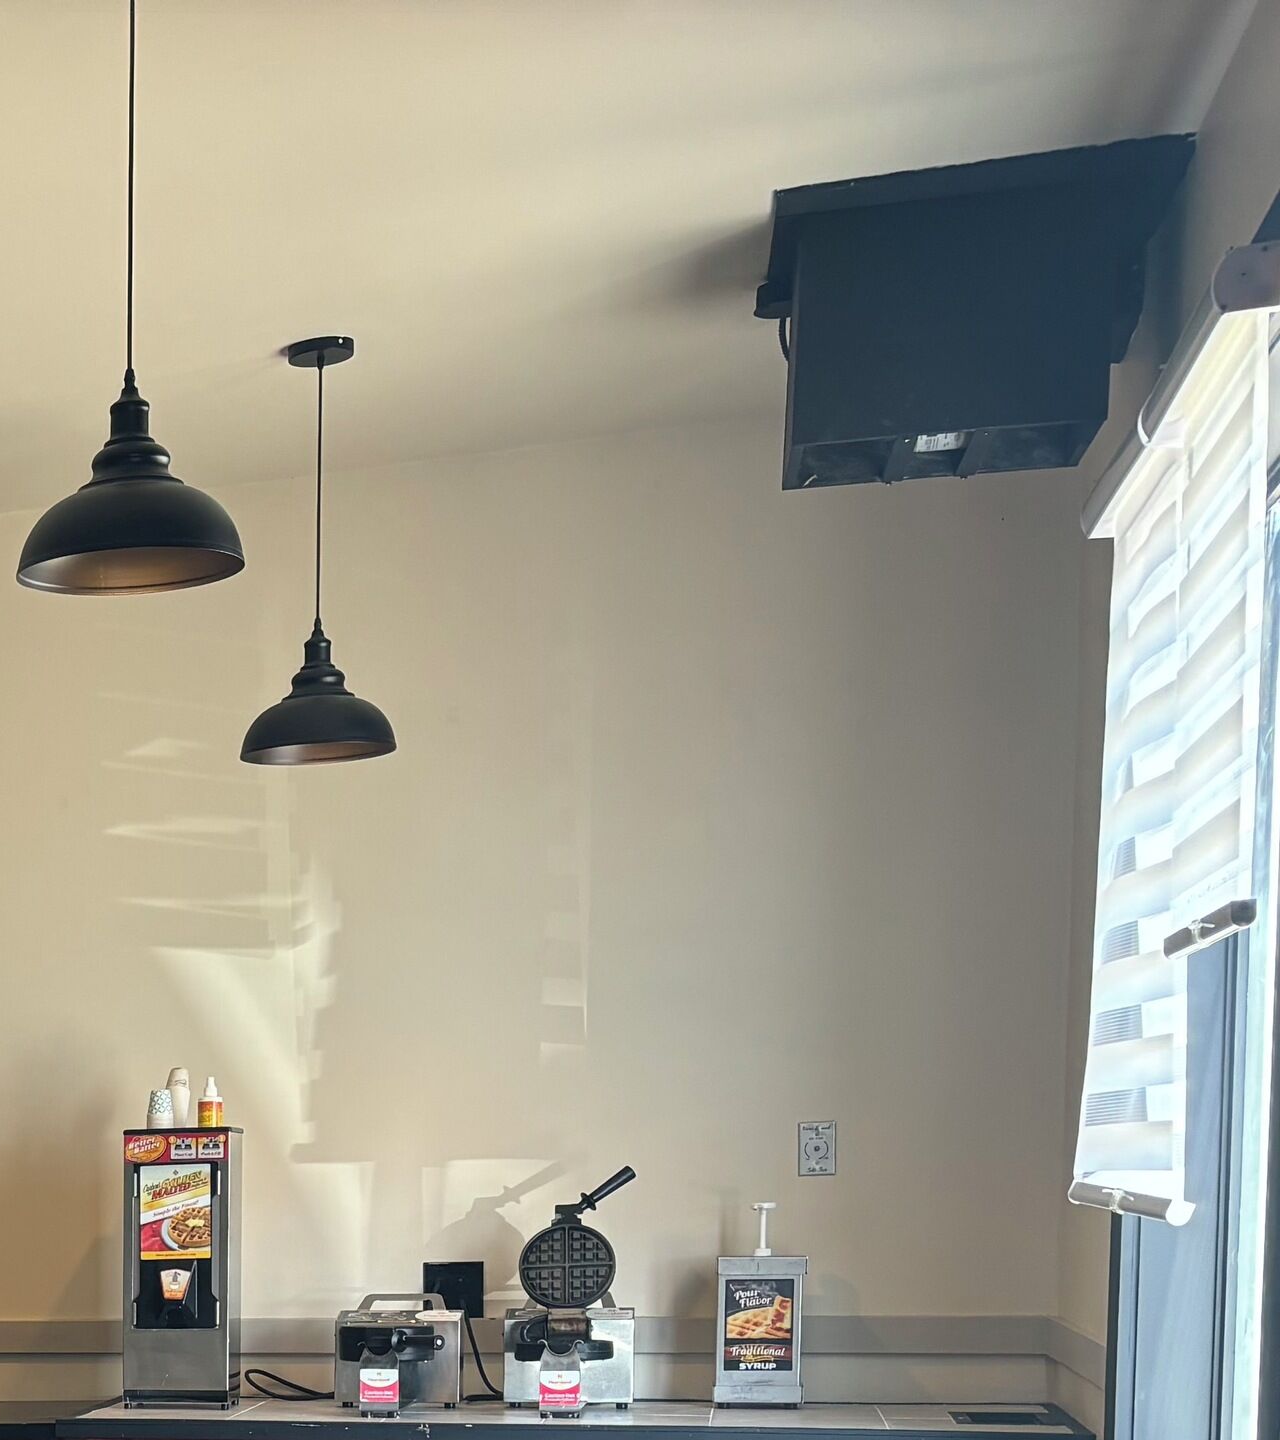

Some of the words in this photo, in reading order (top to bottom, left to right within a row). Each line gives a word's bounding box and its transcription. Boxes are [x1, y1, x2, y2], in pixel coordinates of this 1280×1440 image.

[733, 1289, 761, 1301] Pour
[739, 1297, 773, 1308] Flavor
[730, 1346, 786, 1356] Traditional
[739, 1362, 777, 1370] SYRUP
